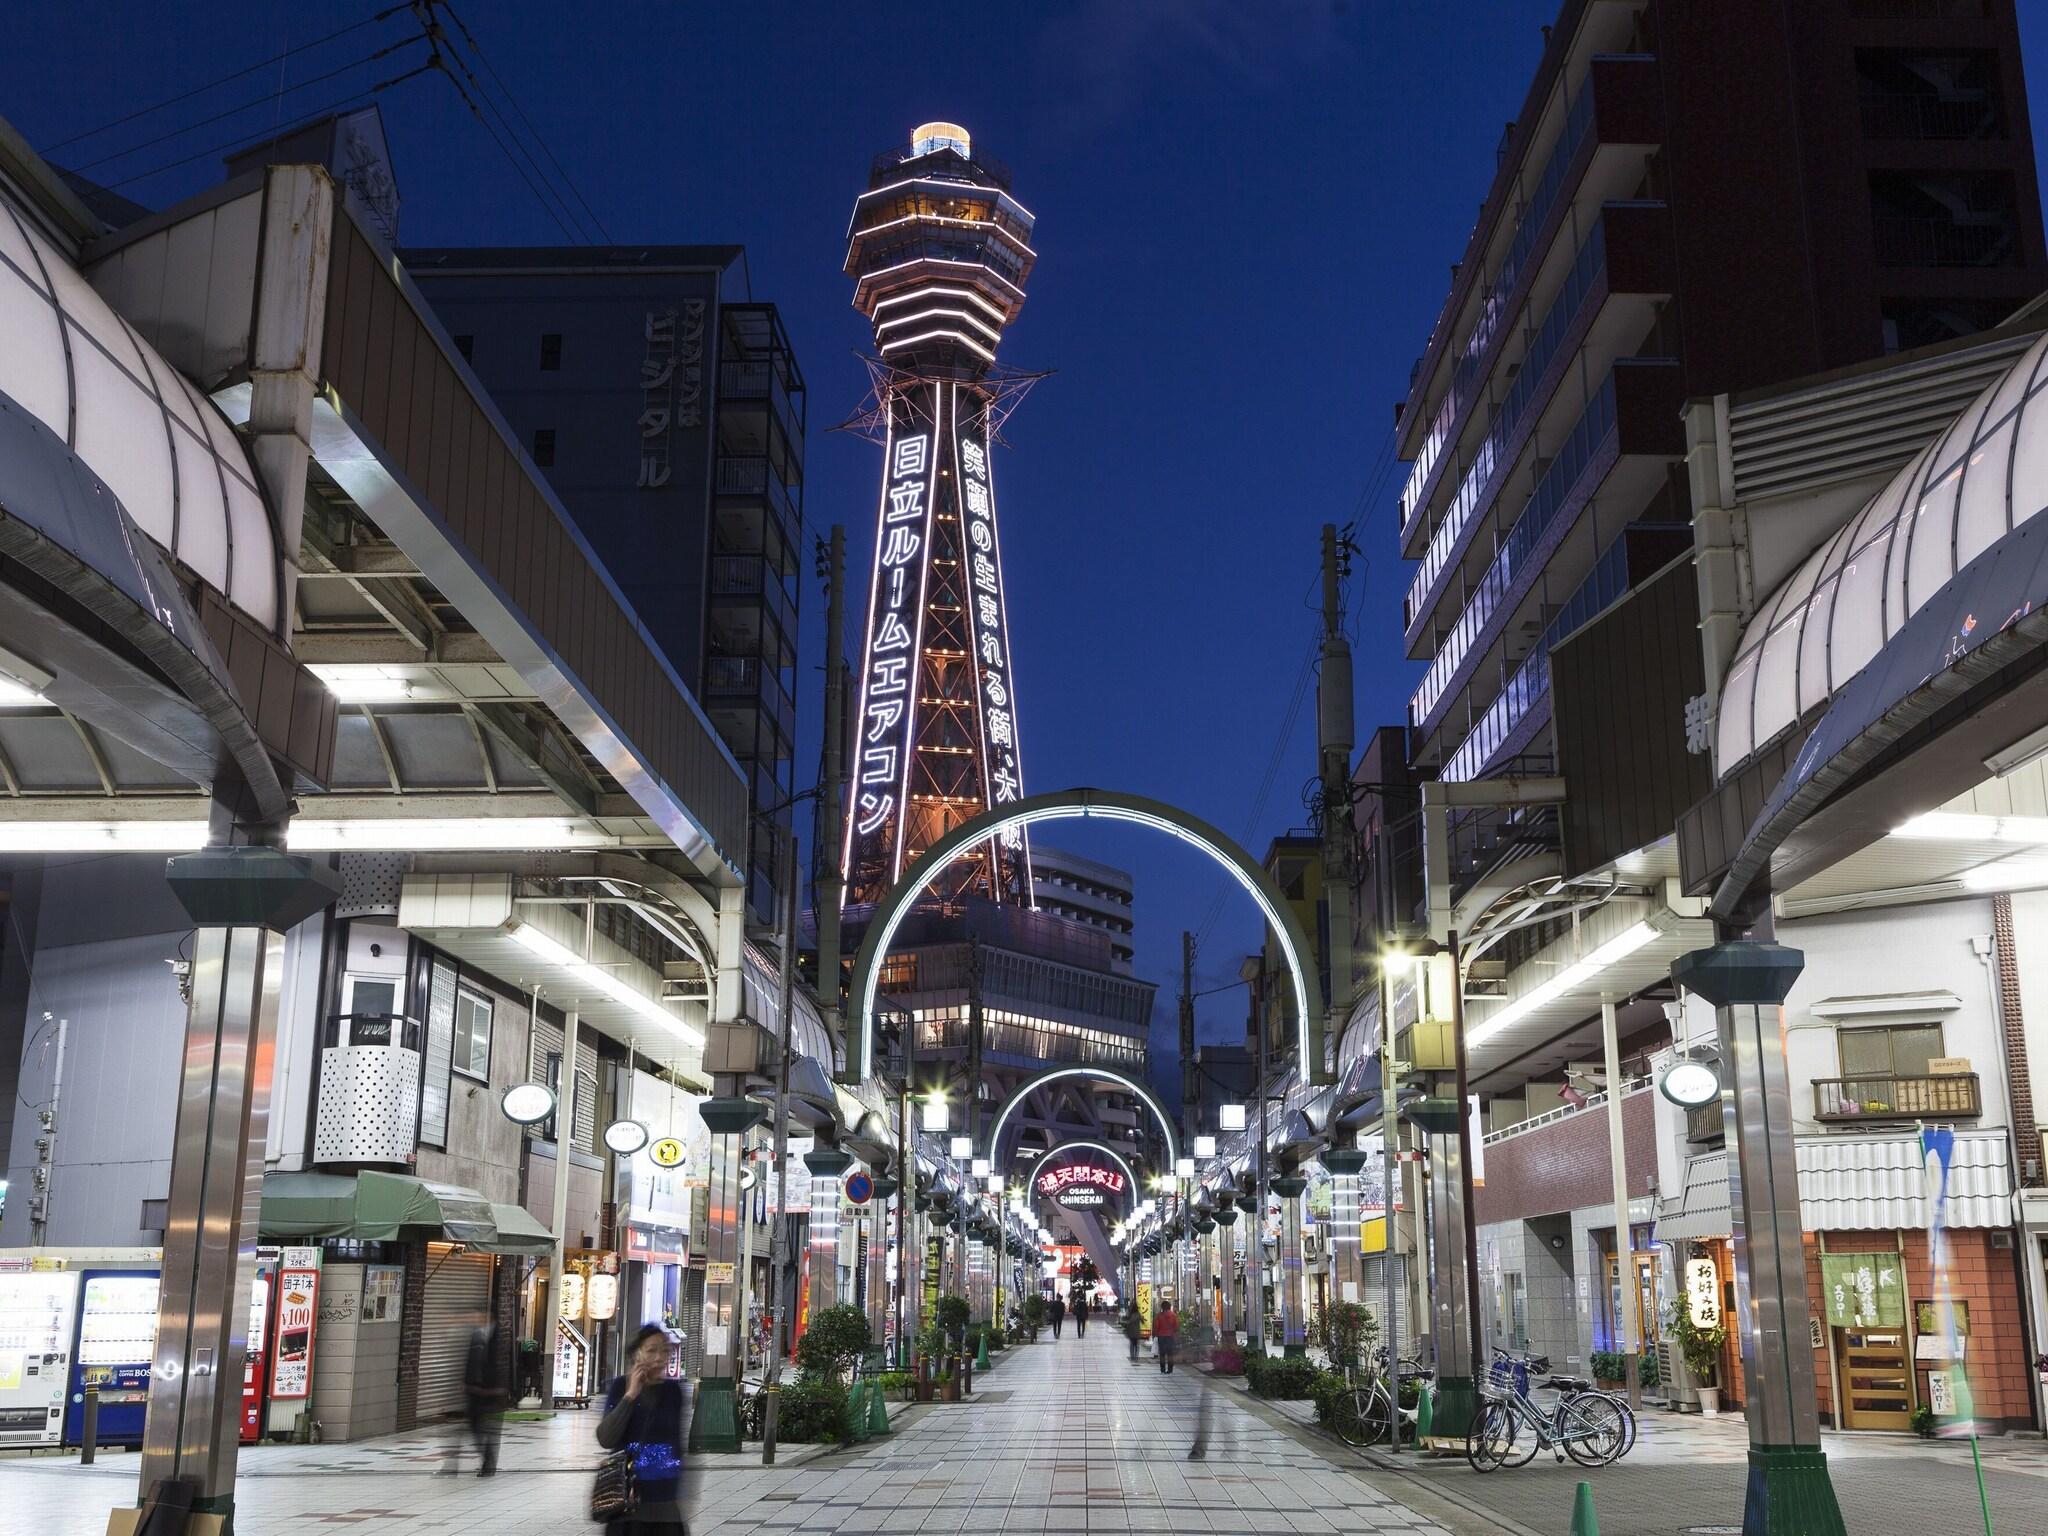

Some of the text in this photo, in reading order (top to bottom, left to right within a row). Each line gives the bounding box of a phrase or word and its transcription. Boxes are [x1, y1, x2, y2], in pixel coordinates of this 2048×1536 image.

[857, 434, 928, 835] 日立ルームエアコン
[1059, 1195, 1103, 1205] SHINSEKAI
[845, 1207, 870, 1216] 自動車
[284, 1279, 314, 1290] 団子1本
[1697, 1265, 1716, 1321] お好み焼
[282, 1308, 311, 1326] ¥100
